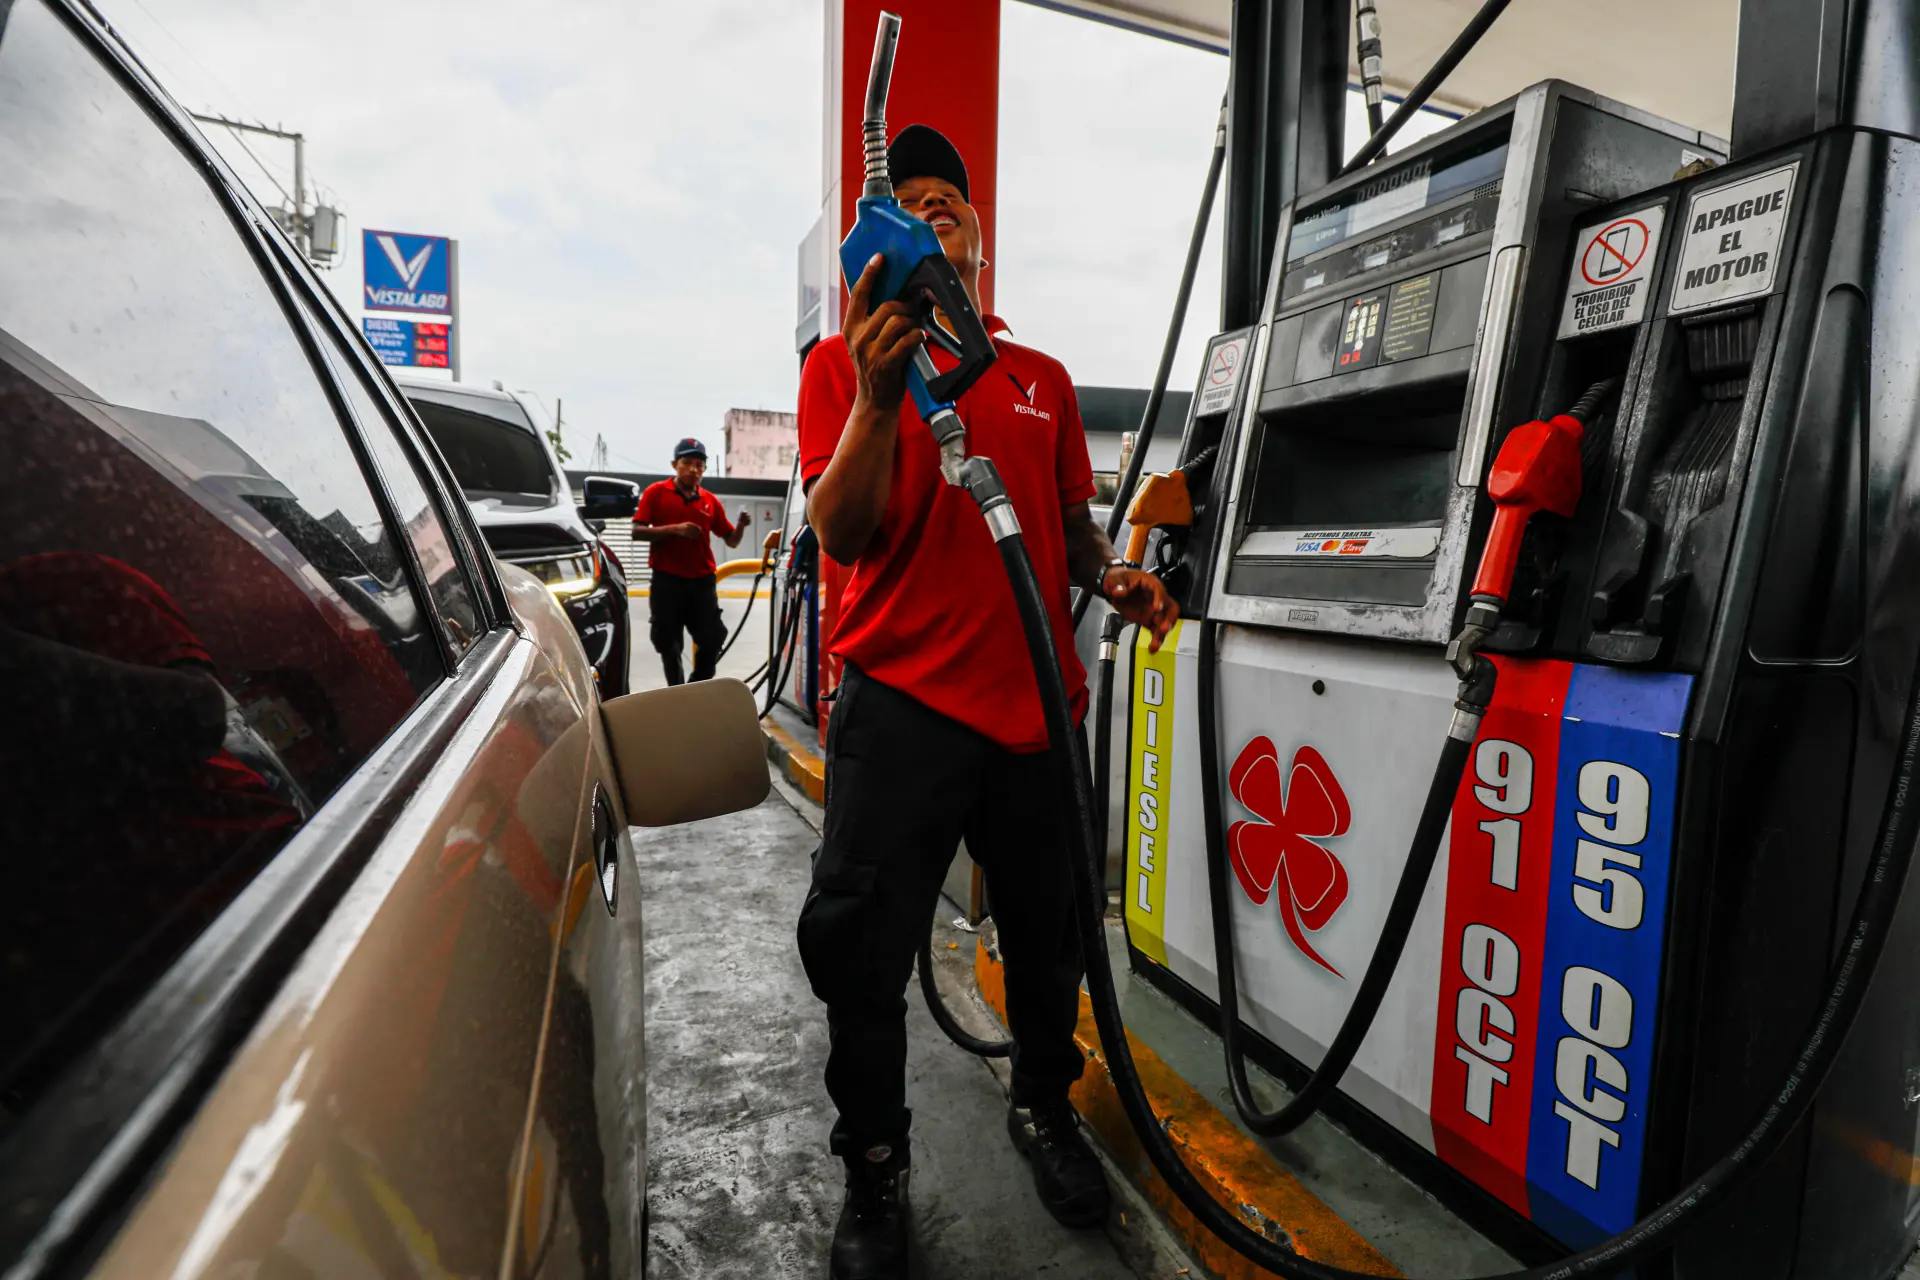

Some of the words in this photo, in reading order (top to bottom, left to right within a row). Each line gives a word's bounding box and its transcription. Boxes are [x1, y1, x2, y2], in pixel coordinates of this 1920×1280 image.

[1691, 189, 1785, 235] APAGUE
[1718, 230, 1742, 254] EL
[1683, 251, 1769, 290] MOTOR
[366, 285, 449, 309] VISTALAGO
[1574, 308, 1585, 320] EL
[1587, 301, 1610, 317] USO
[1611, 296, 1631, 311] DEL
[1575, 283, 1636, 309] PROHIBIDO
[1578, 309, 1625, 330] CELULAR
[1013, 403, 1051, 422] VISTALAGO
[1295, 542, 1321, 552] VISA
[1342, 543, 1366, 552] Clave
[1137, 667, 1165, 915] DIESEL
[1472, 738, 1535, 892] 91
[1571, 759, 1651, 932] 95
[1873, 865, 1886, 883] USA
[1453, 922, 1520, 1126] OCT
[1552, 965, 1635, 1192] OCT
